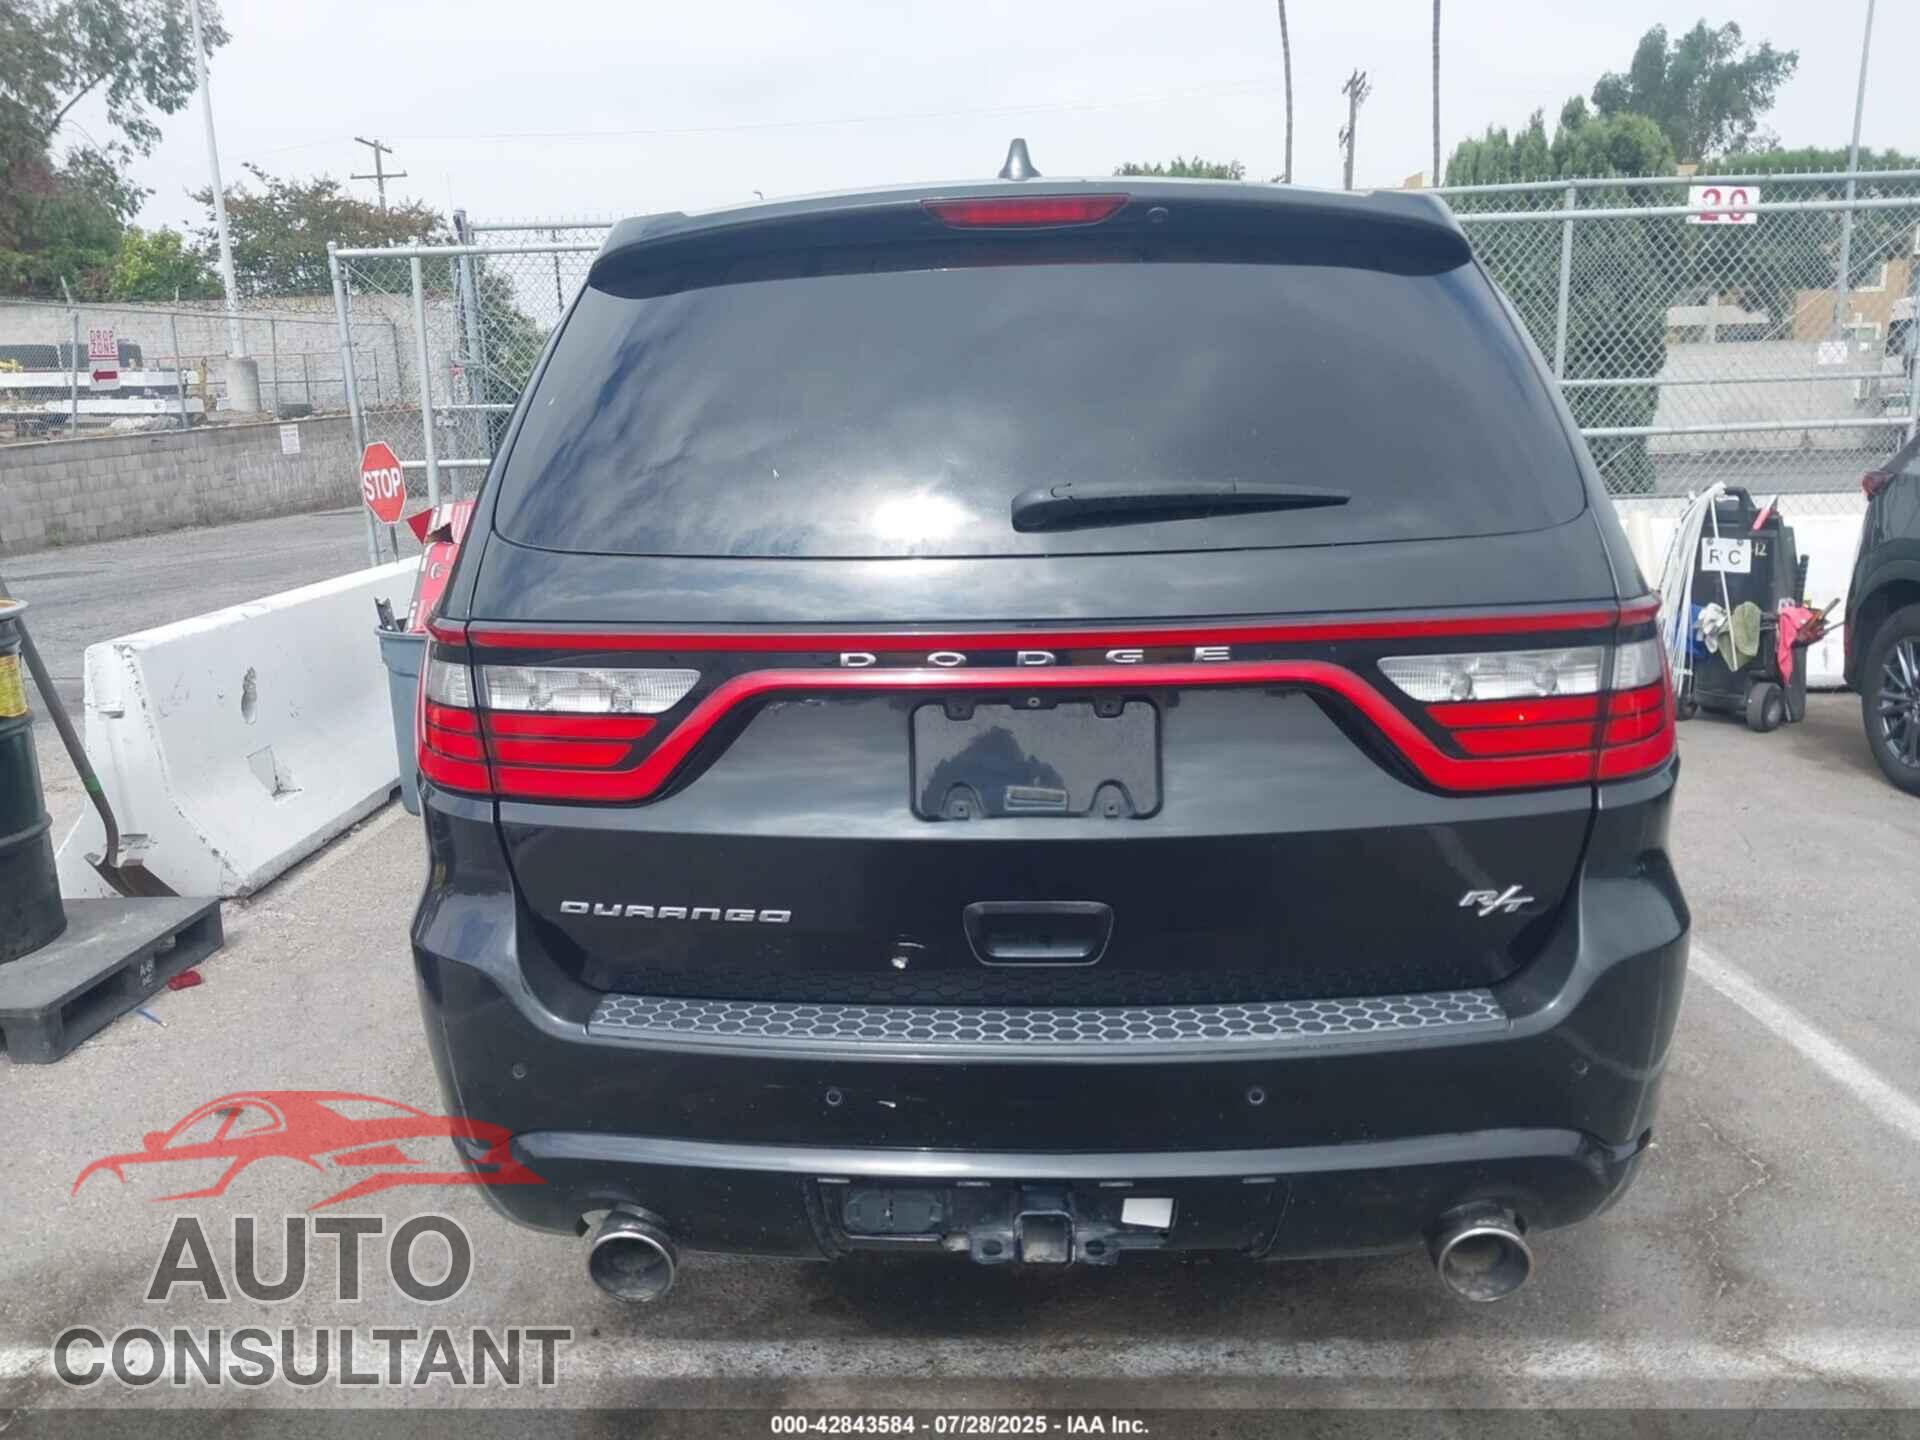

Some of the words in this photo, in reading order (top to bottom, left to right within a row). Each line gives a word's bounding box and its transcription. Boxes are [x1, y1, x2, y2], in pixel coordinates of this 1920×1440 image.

[1700, 188, 1748, 221] 20
[90, 342, 117, 354] ZONE
[363, 467, 401, 501] STOP
[839, 645, 1231, 668] DODGE
[560, 900, 792, 923] DURANGO
[1459, 884, 1535, 917] R/T
